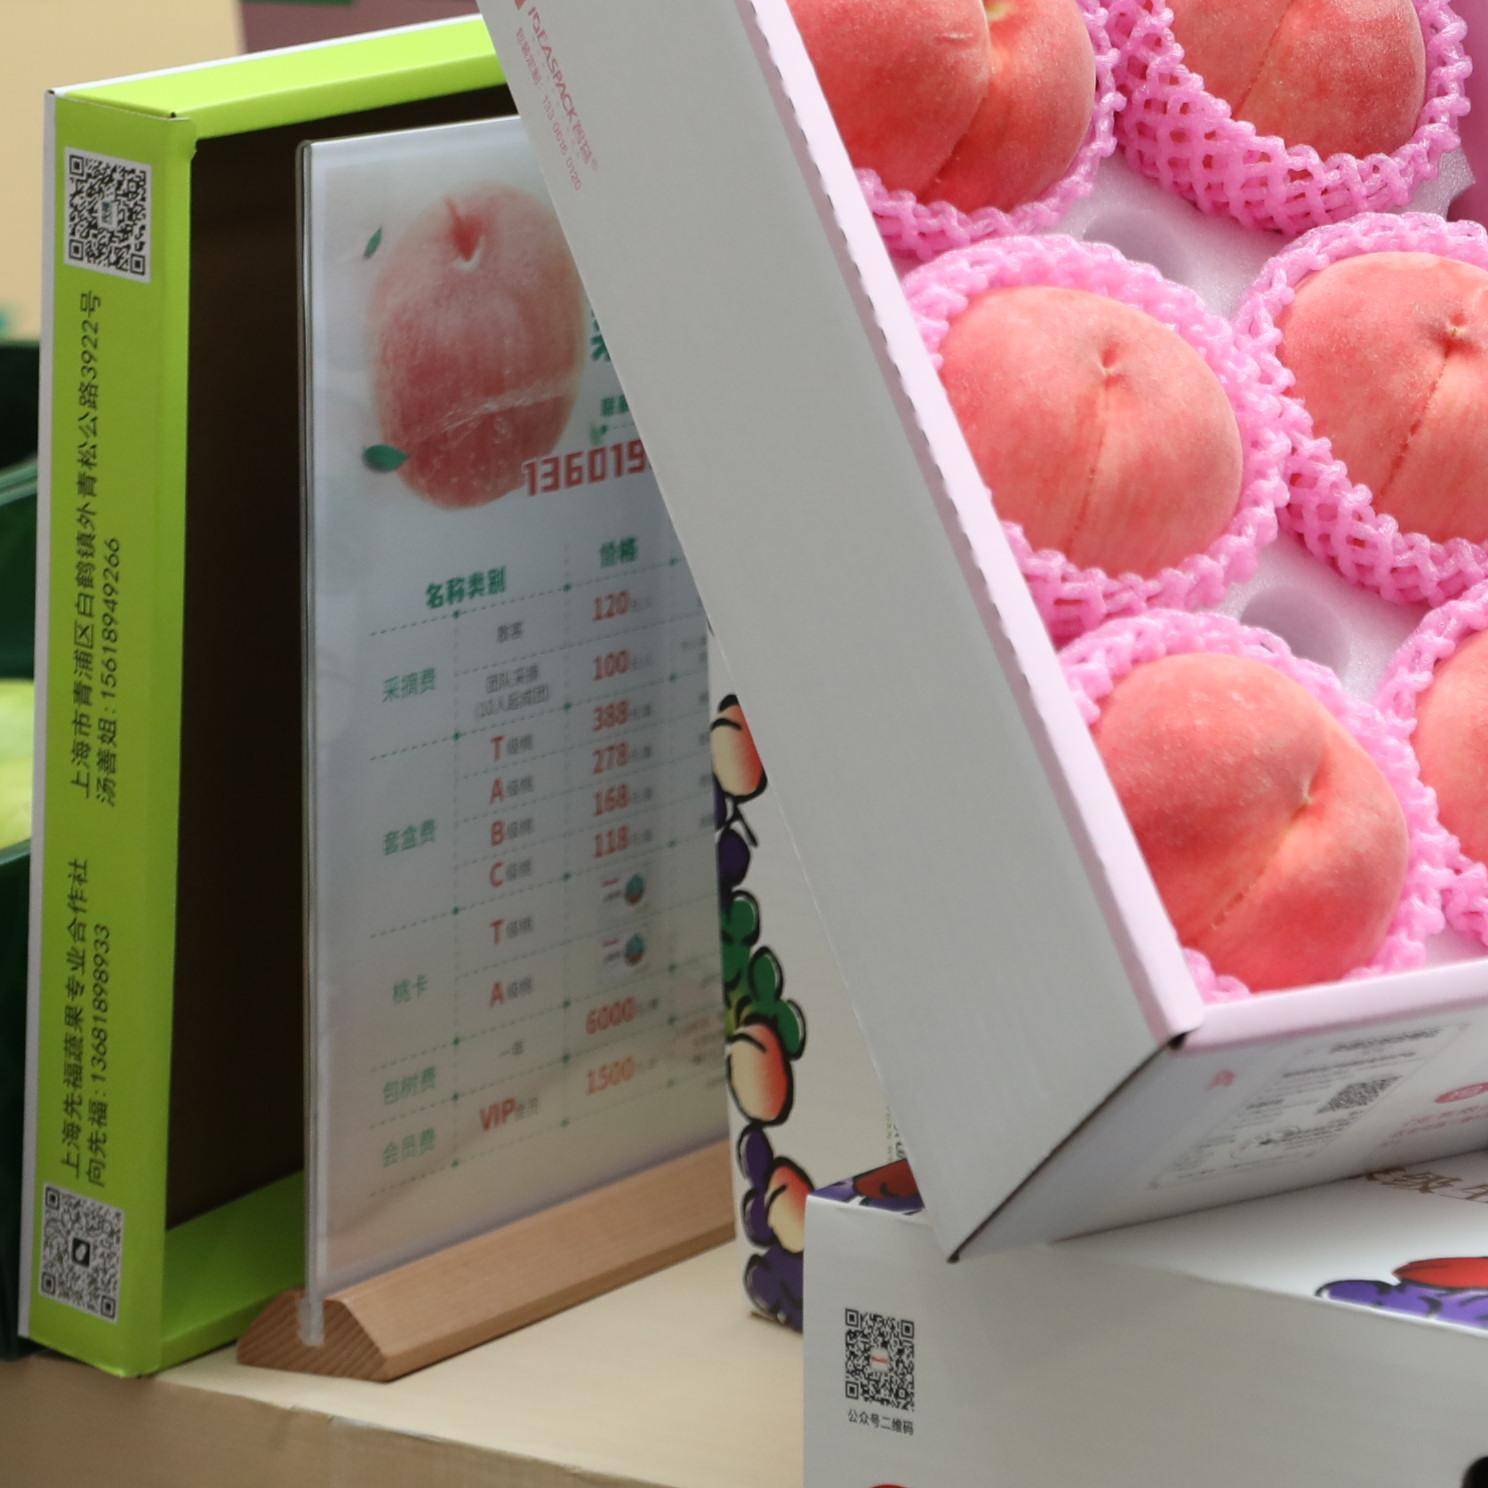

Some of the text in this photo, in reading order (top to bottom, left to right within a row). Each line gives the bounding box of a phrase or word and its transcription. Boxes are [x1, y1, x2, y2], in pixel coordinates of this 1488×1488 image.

[522, 438, 653, 497] 136019
[70, 289, 102, 800] 上海市青浦区白鹤镇外青松公路3922号
[425, 567, 507, 610] 名称类别
[592, 590, 630, 622] 120
[382, 668, 436, 703] 采摘费
[592, 650, 631, 681] 100
[61, 858, 89, 1180] 上海先福蔬果专业合作社
[848, 1408, 915, 1436] 公众号二维码
